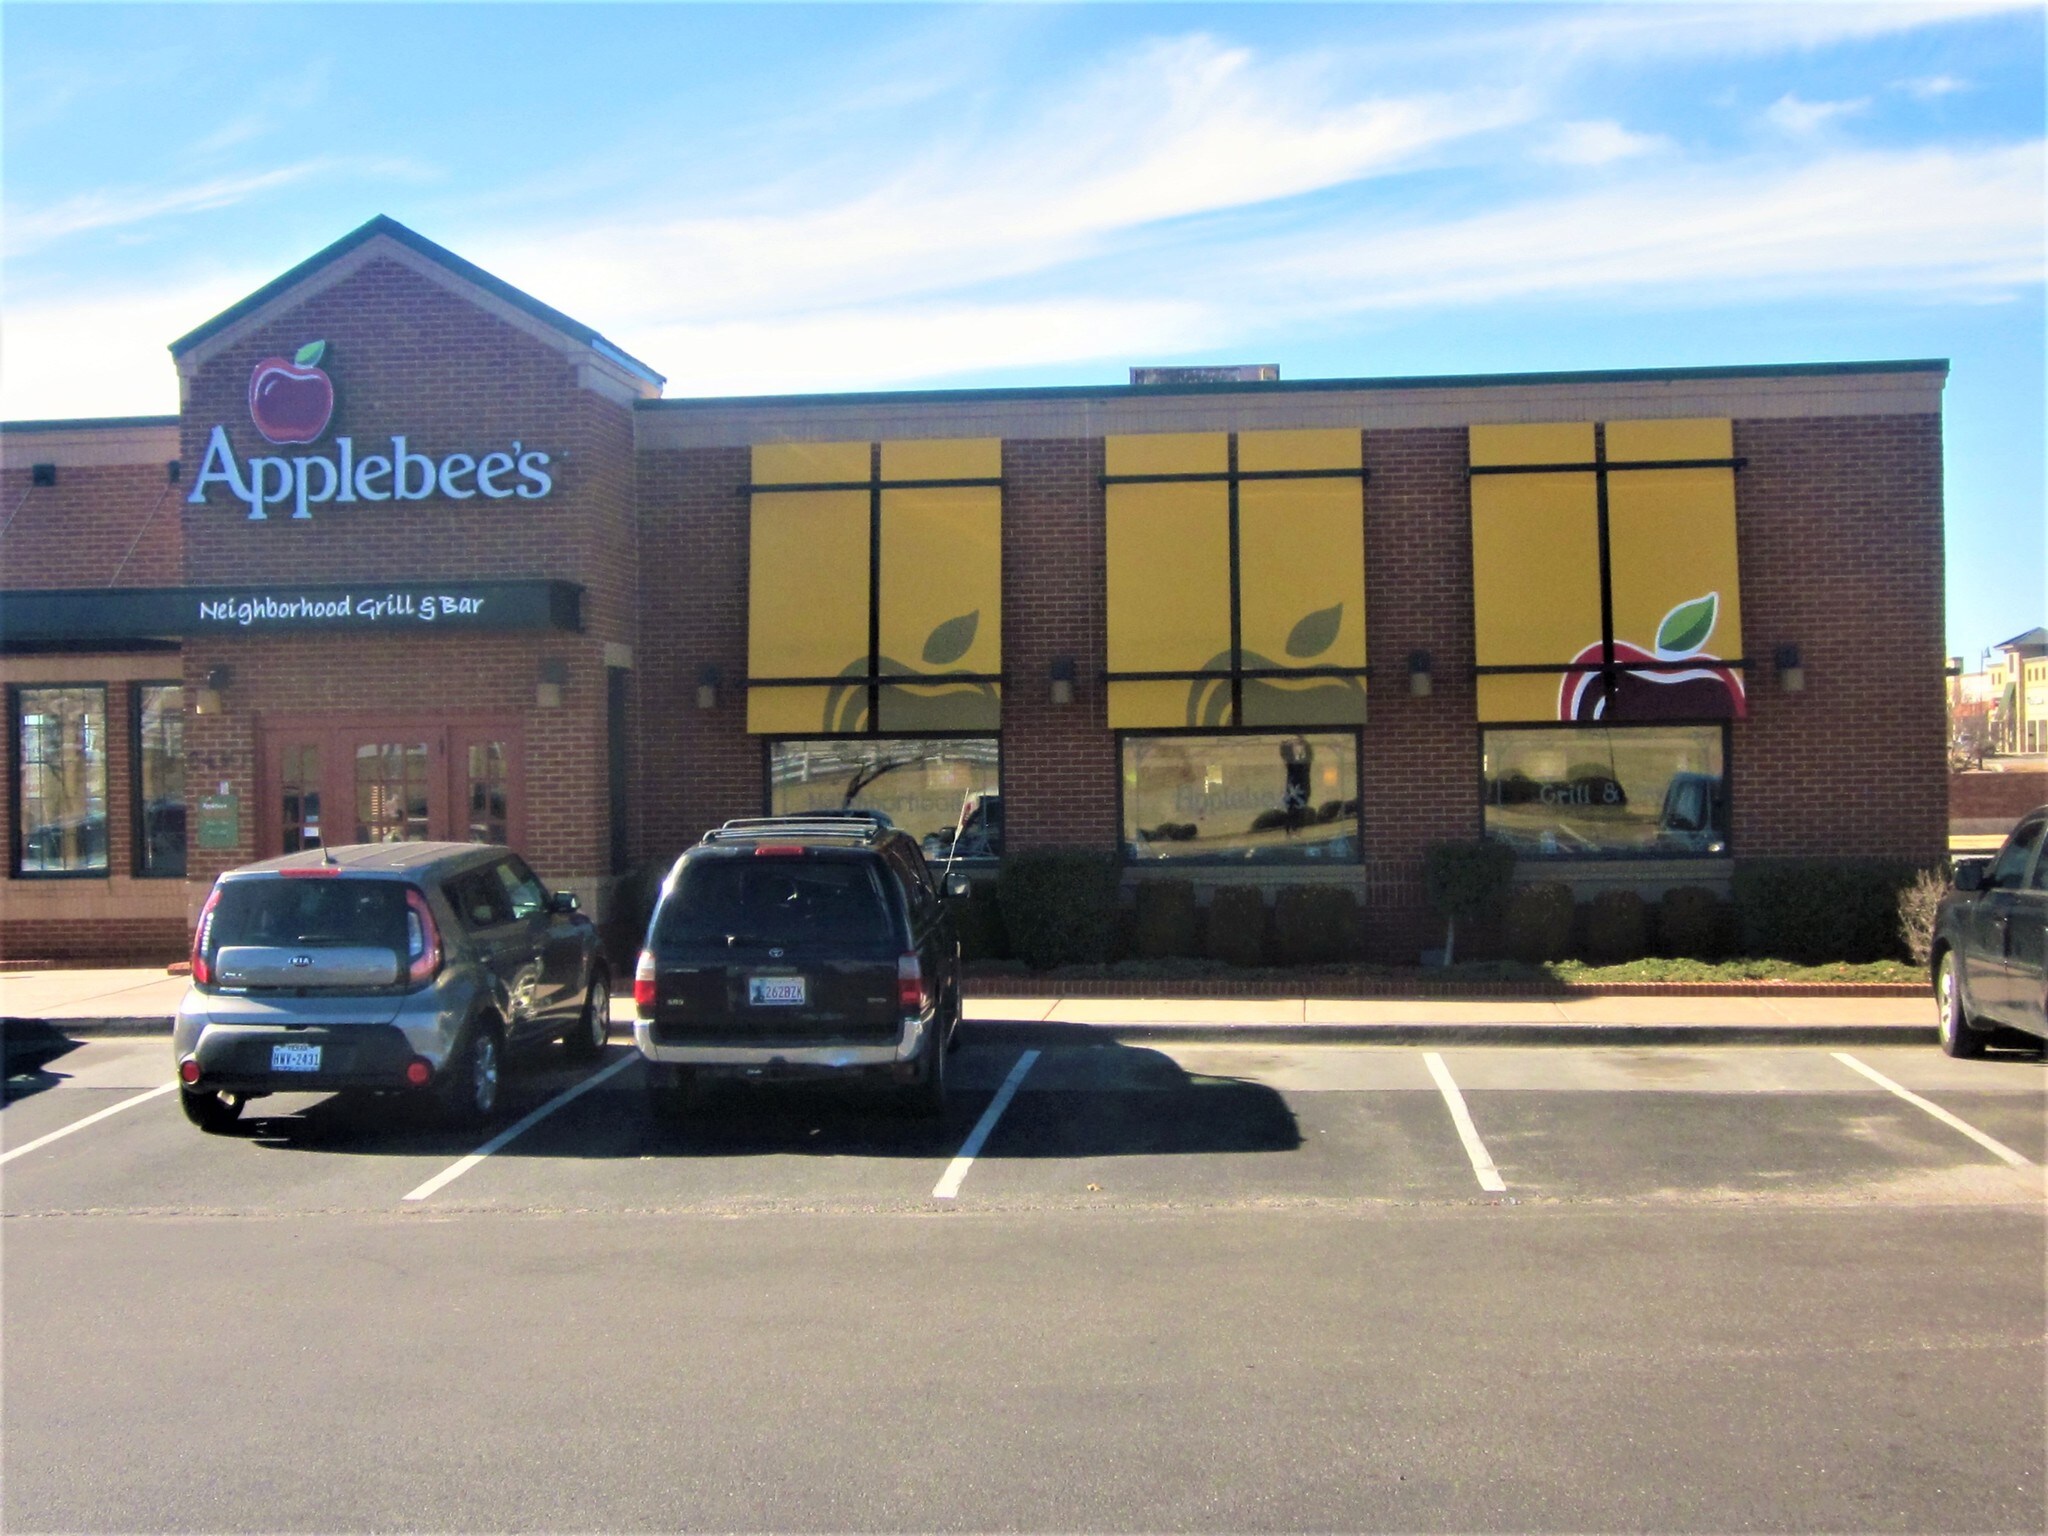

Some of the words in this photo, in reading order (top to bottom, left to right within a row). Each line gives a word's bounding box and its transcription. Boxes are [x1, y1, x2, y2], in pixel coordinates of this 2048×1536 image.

[187, 425, 553, 519] Applebee's
[199, 595, 351, 625] Neighborhood
[356, 594, 414, 620] Grill
[418, 597, 436, 620] &
[438, 596, 484, 614] Bar
[1540, 784, 1591, 805] Grill
[1602, 782, 1620, 804] &
[766, 985, 802, 999] 262BZK
